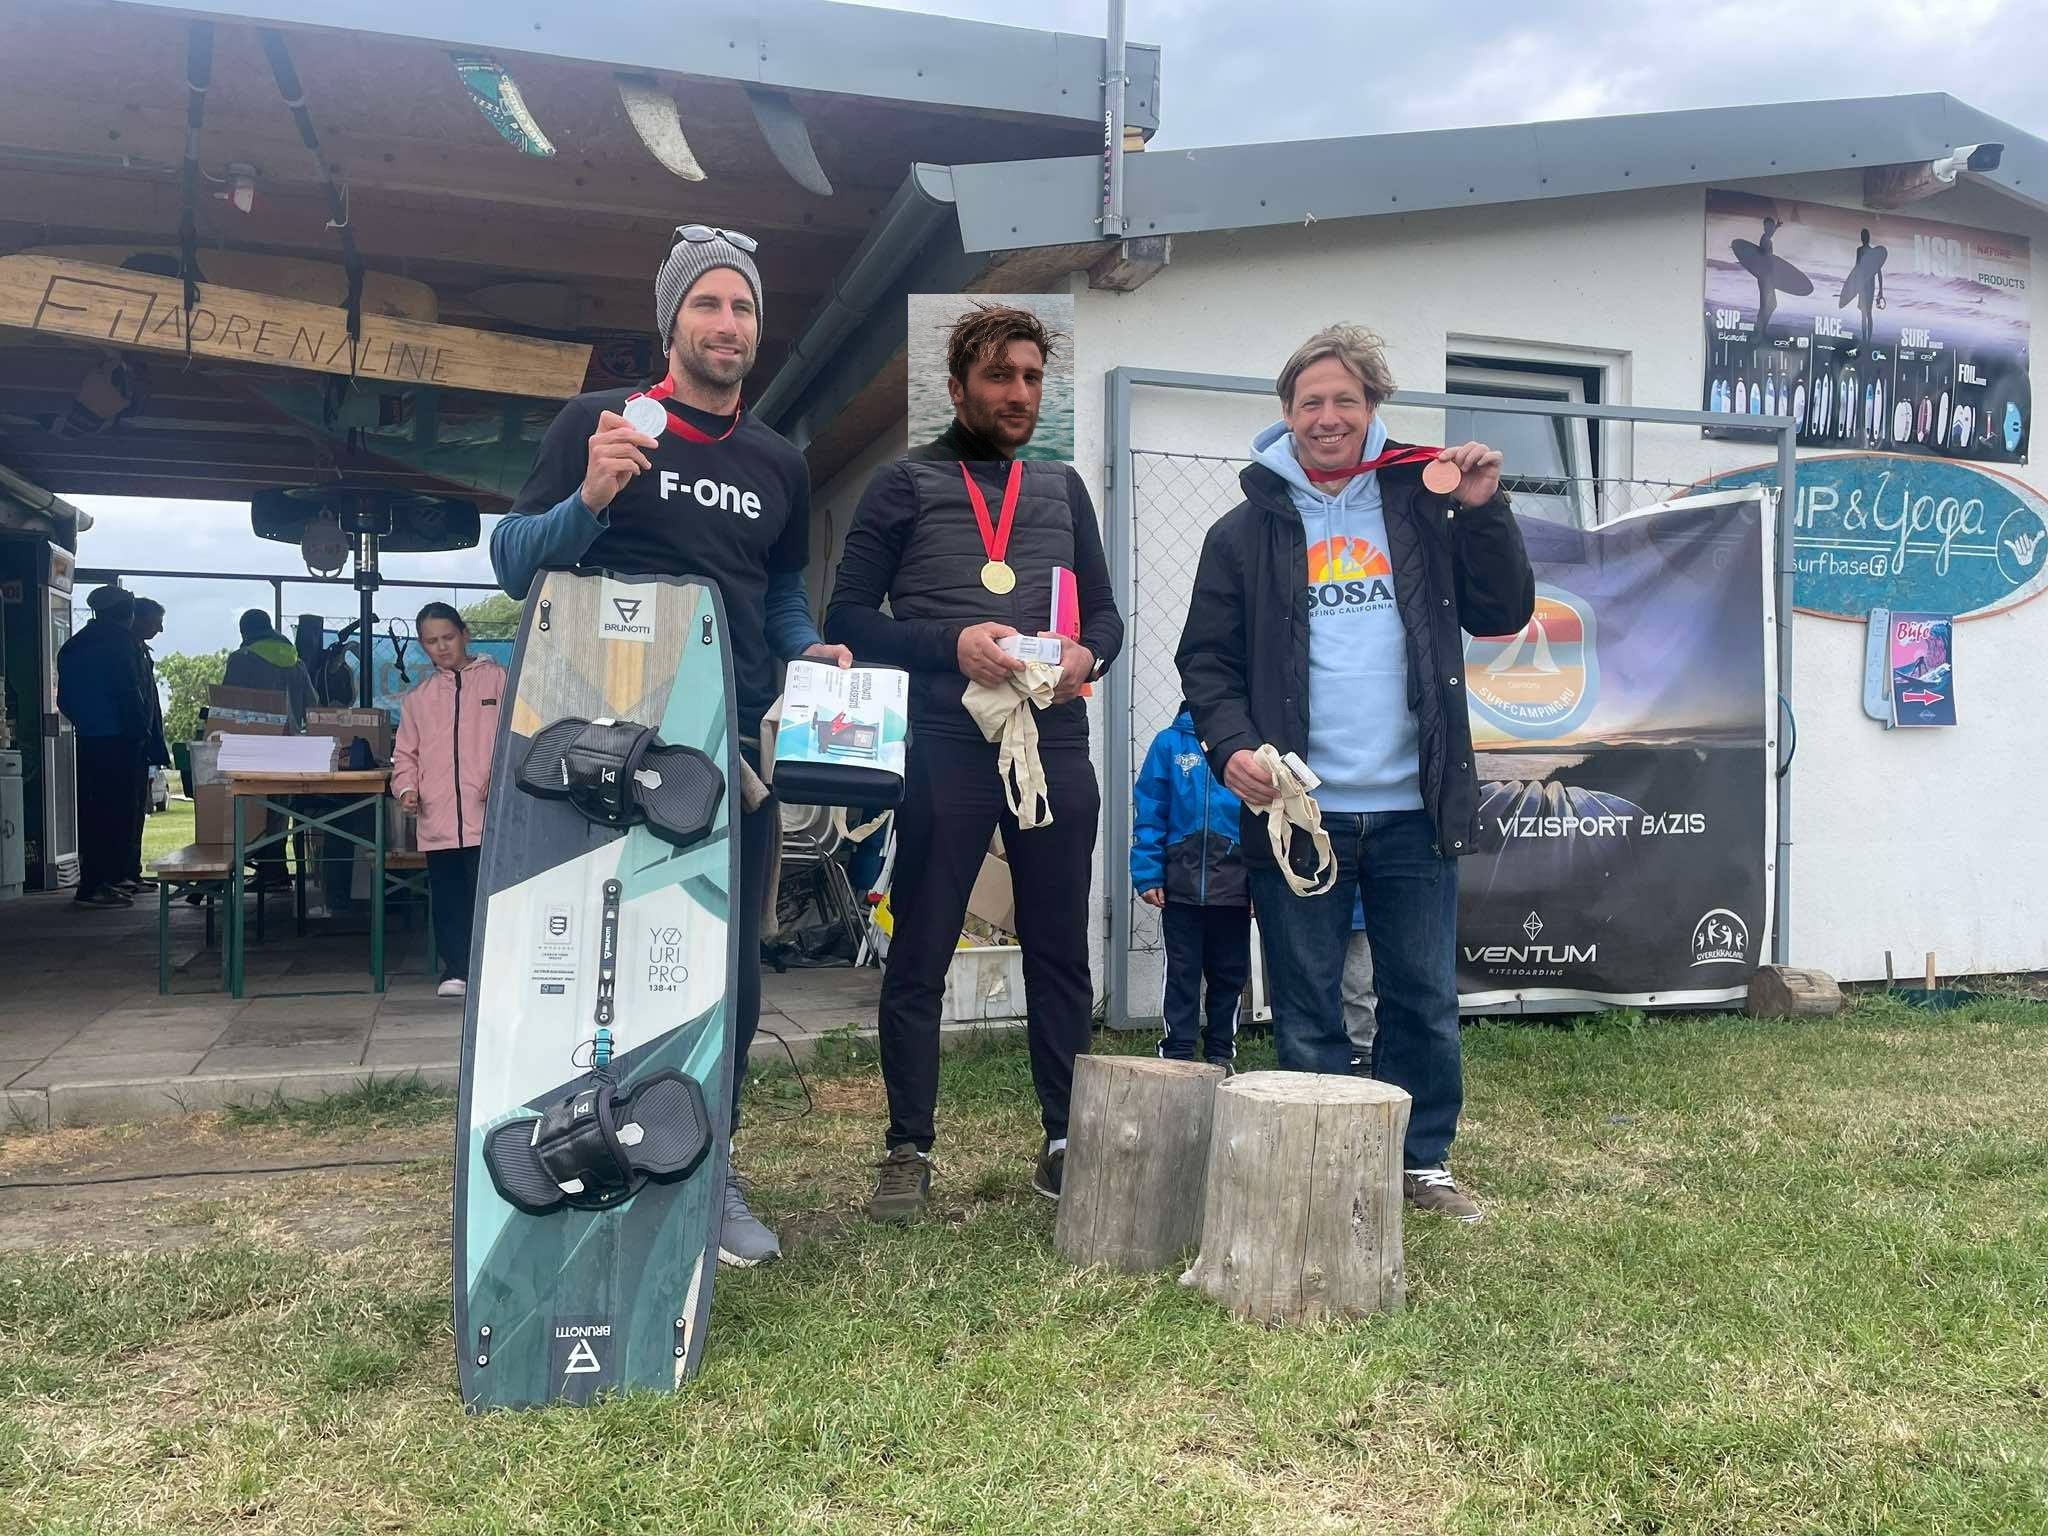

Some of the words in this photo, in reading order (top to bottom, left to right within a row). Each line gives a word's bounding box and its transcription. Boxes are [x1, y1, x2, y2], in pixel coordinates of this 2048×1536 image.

[1913, 233, 1962, 277] NSP
[1978, 272, 2025, 290] PRODUCTS
[1716, 309, 1740, 330] SUP
[1815, 316, 1842, 337] RACE
[153, 304, 455, 384] ADRENALINE
[1901, 327, 1930, 349] SURF
[1843, 489, 1867, 530] &
[1873, 471, 1986, 577] Yoga
[1339, 603, 1393, 614] CALIFORNIA
[604, 623, 650, 634] BRUNOTTI
[1641, 811, 1706, 836] BÁZIS
[649, 946, 680, 963] URI
[1463, 944, 1597, 963] VENTUM
[648, 965, 689, 983] PRO
[1488, 968, 1563, 976] KITEBOARDING
[555, 1325, 611, 1338] BRUNOTTI
